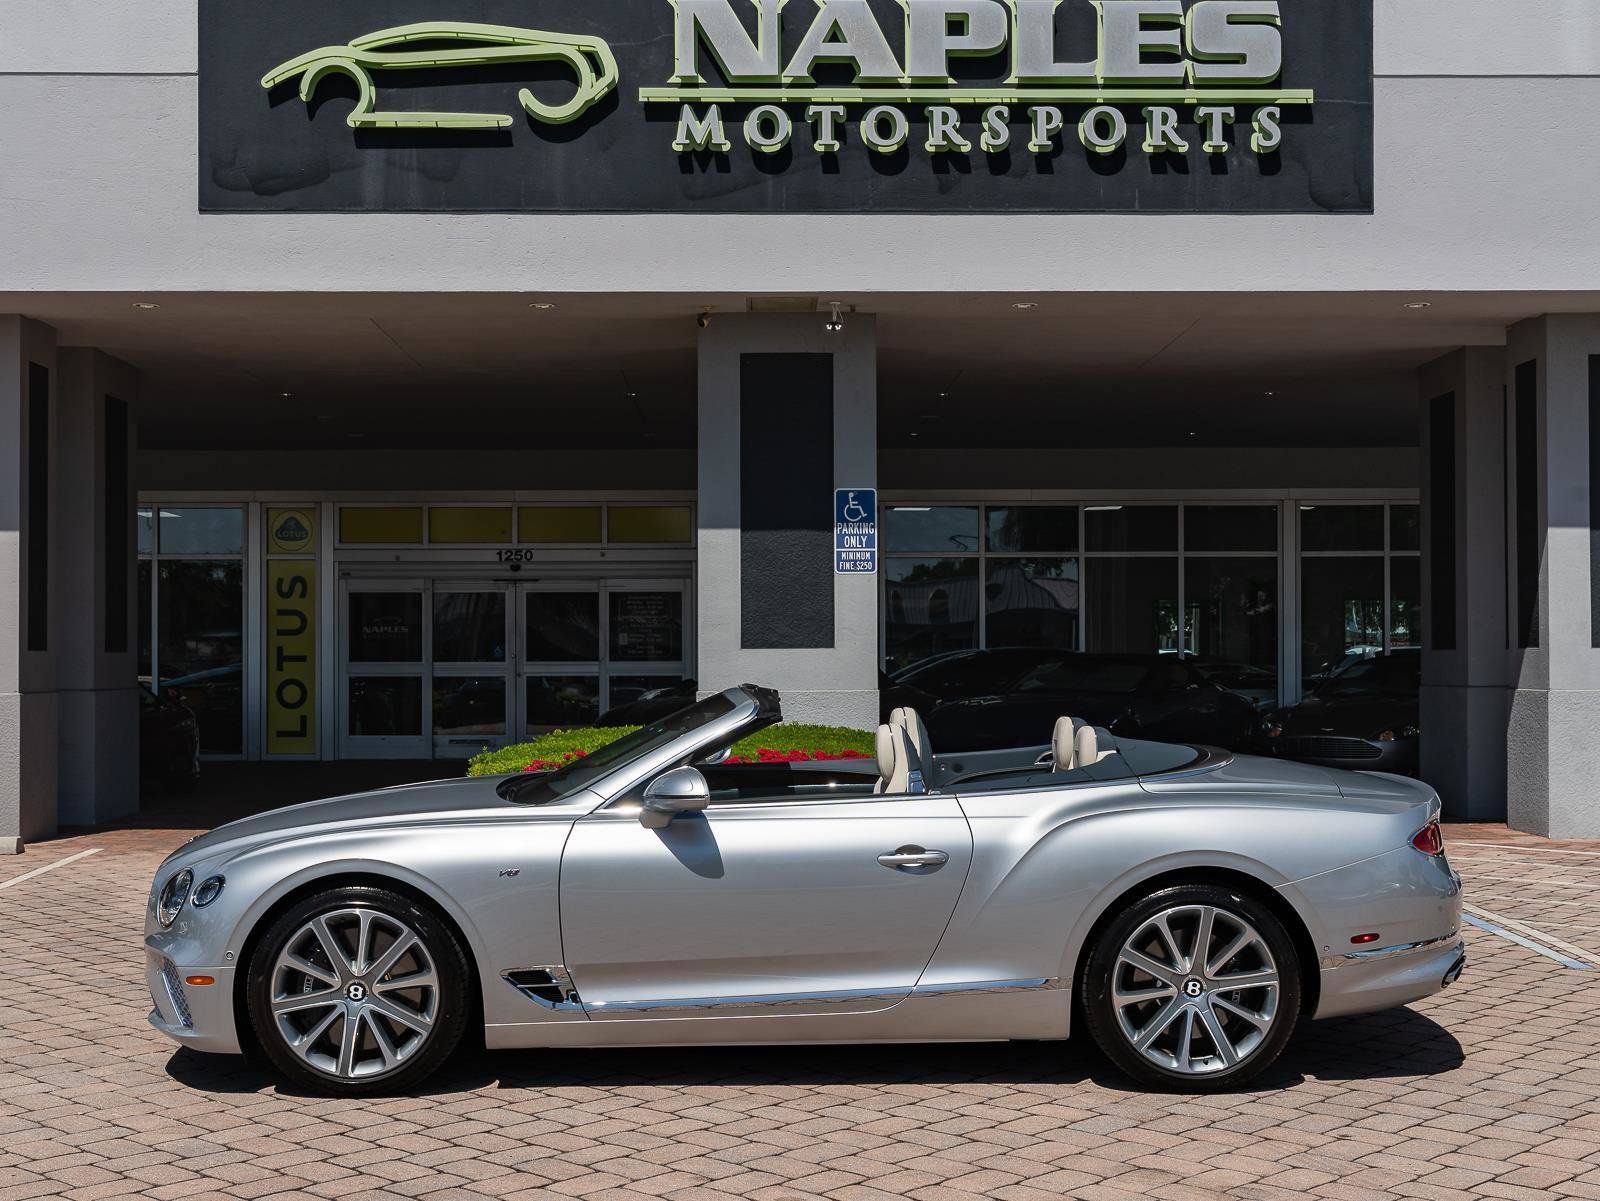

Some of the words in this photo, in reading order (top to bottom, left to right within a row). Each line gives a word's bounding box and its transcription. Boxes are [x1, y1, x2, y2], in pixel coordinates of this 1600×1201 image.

[667, 0, 1282, 84] NAPLES
[672, 104, 1282, 152] MOTORSPORTS
[277, 530, 308, 538] LOTUS
[837, 522, 875, 535] PARKING
[844, 535, 868, 548] ONLY
[496, 549, 533, 562] 1250
[841, 551, 871, 561] MINIMUM
[839, 561, 855, 570] FINE
[856, 561, 873, 571] $250
[276, 575, 308, 738] LOTUS
